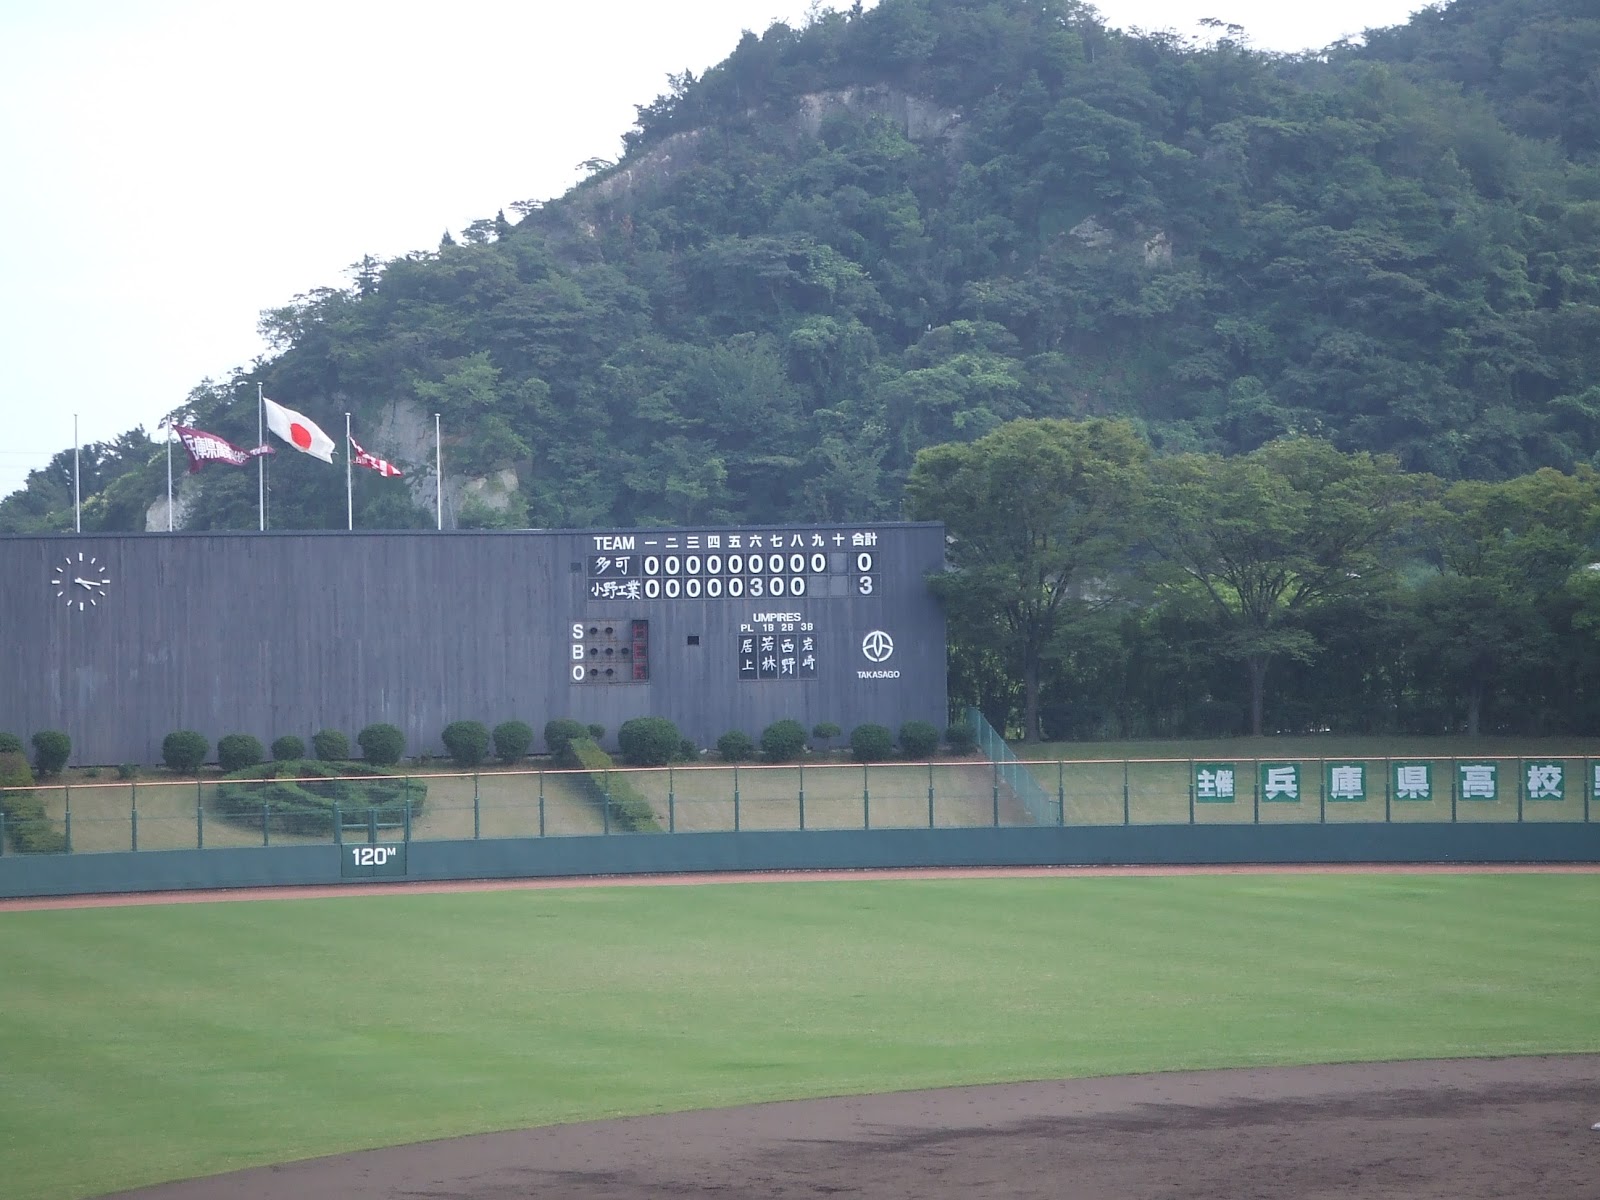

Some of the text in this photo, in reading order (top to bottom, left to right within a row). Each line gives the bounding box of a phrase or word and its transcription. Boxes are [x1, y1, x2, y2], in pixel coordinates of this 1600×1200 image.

[593, 536, 635, 551] TEAM
[665, 537, 679, 549] 二
[686, 536, 700, 549] 三
[707, 536, 721, 549] 四
[728, 535, 742, 549] 五
[749, 535, 763, 548] 六
[770, 534, 784, 548] 七
[790, 534, 804, 547] 八
[811, 533, 825, 547] 九
[832, 533, 845, 547] 十
[852, 532, 878, 547] 合計
[595, 556, 631, 576] 多可
[857, 553, 872, 572] 0
[590, 579, 641, 600] 小野工業
[859, 576, 873, 595] 3
[753, 612, 802, 622] UMPIRES
[572, 622, 585, 640] S
[740, 622, 814, 632] PL 1B 2B 3B
[572, 643, 585, 661] B
[740, 638, 755, 671] 居上
[761, 636, 777, 671] 若林
[781, 638, 796, 675] 西野
[857, 670, 901, 679] TAKASAGO
[1196, 768, 1235, 798] 主催
